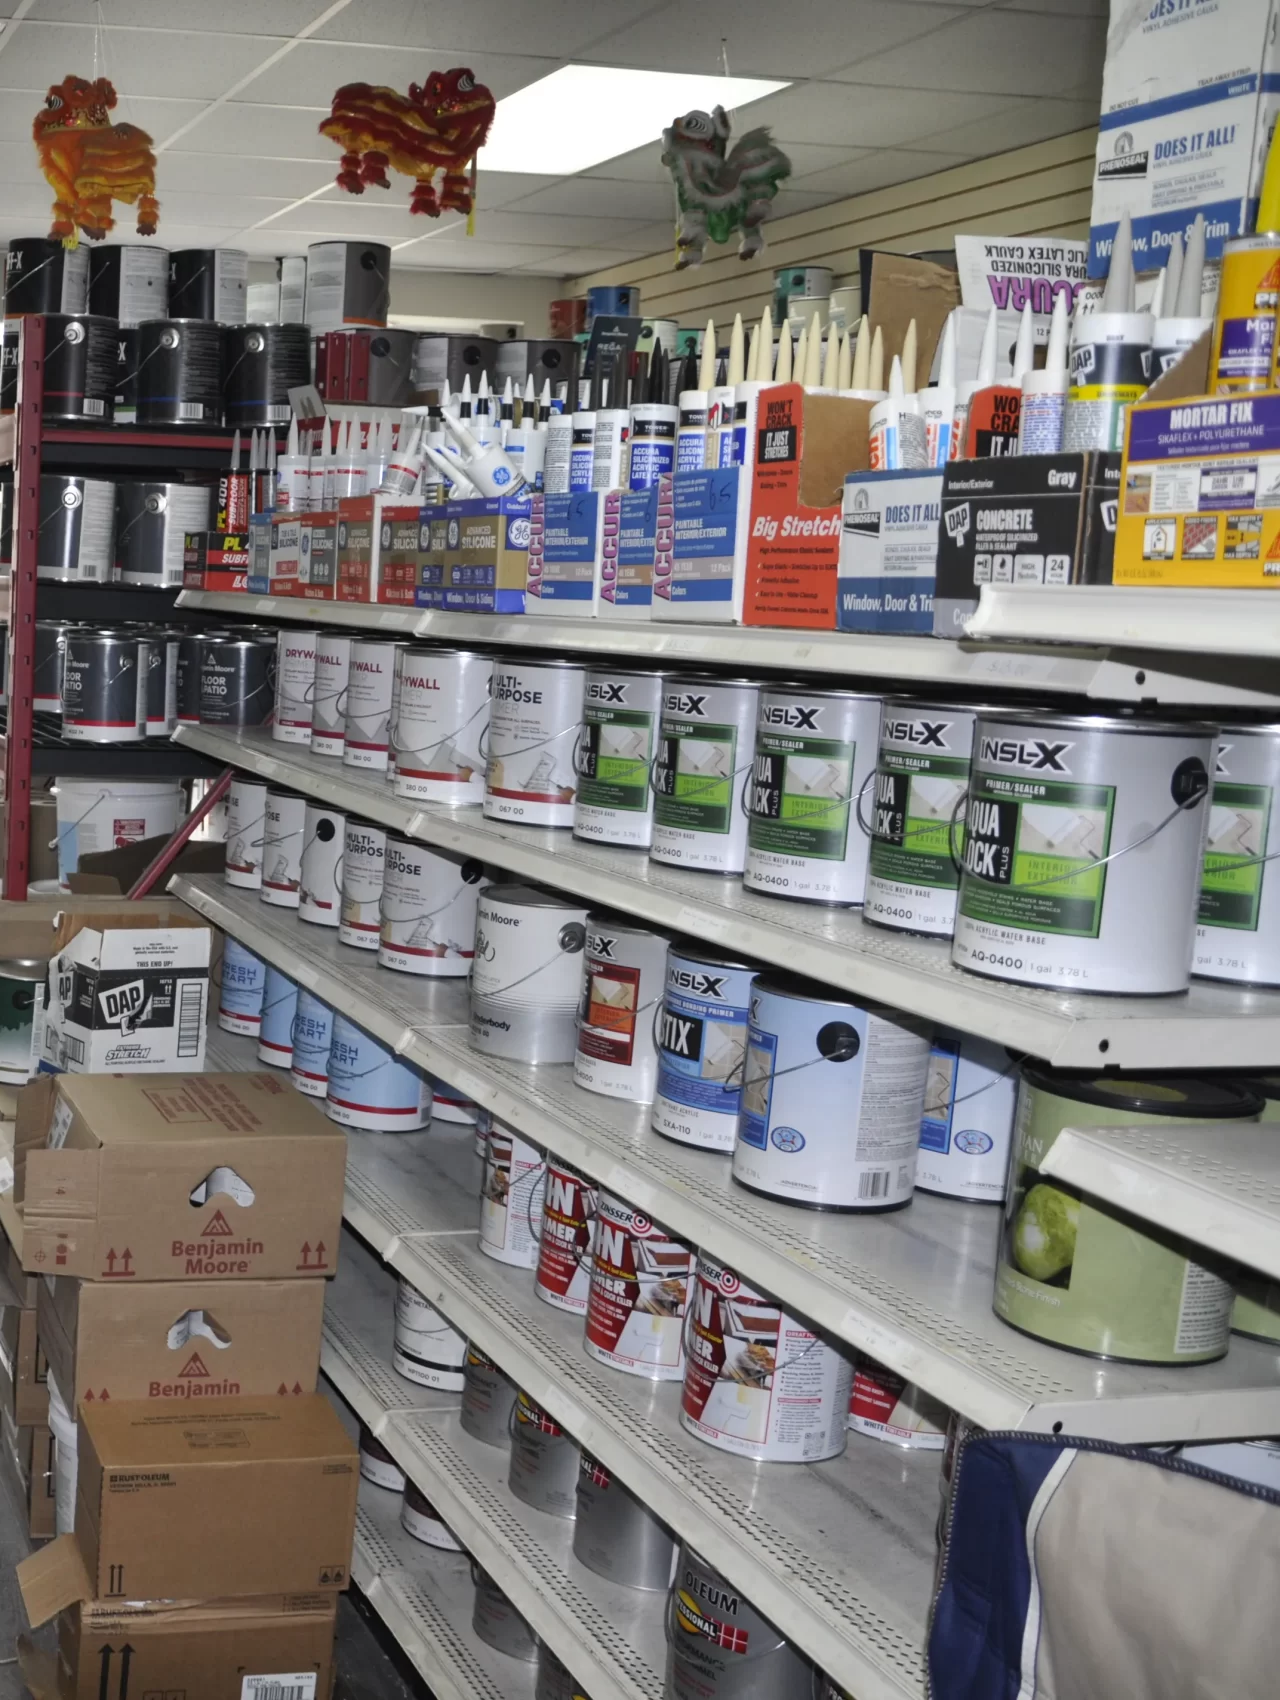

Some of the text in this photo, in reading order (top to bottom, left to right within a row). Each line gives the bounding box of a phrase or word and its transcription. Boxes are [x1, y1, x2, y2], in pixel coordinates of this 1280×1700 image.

[1228, 82, 1251, 95] WHITE
[1154, 125, 1236, 161] DOES IT ALL!
[1099, 153, 1147, 173] PHENOSEAL
[984, 245, 1064, 261] LATEX CAULK
[991, 260, 1061, 276] SILICONIZED
[767, 400, 793, 415] WON'T
[1170, 401, 1254, 429] MORTAR FIX
[765, 413, 792, 428] CRACK
[679, 437, 704, 447] ACCURA
[765, 430, 789, 447] IT JUST
[1158, 424, 1265, 445] SIKAFLEX POLYURETHANE
[632, 456, 670, 465] SILICONIZED
[633, 447, 660, 456] ACCURA
[631, 463, 660, 472] ACRYLIC
[948, 479, 994, 490] Interior/Exterior
[1047, 469, 1076, 488] Gray
[217, 478, 228, 529] PL 400
[228, 477, 239, 525] SUBFLOOR
[885, 503, 941, 523] DOES IT ALL
[949, 508, 968, 532] DAP
[976, 509, 1034, 531] CONCRETE
[466, 525, 492, 536] ADVANCED
[675, 518, 703, 529] PAINTABLE
[752, 514, 841, 541] Big Stretch
[223, 536, 242, 551] PL
[461, 535, 496, 549] SILICONE
[601, 494, 621, 604] ACCUR
[221, 553, 248, 564] SUBF
[1051, 558, 1065, 572] 24
[842, 593, 935, 612] Window, Door & Tri
[494, 687, 543, 704] URPOSE
[584, 683, 626, 703] NSL-X
[663, 694, 707, 716] NSL-X
[761, 705, 820, 731] NSL-X
[882, 720, 948, 748] NSL-X
[885, 754, 931, 769] PRIMER/SEALER
[980, 738, 1069, 772] INSL-X
[985, 778, 1046, 797] PRIMER/SEALER
[513, 807, 524, 816] 00
[771, 789, 780, 817] PLUS
[346, 842, 383, 858] PURPOS
[790, 859, 806, 868] BASE
[999, 845, 1010, 880] PLUS
[753, 871, 789, 888] AQ-0400
[895, 885, 931, 899] WATER BASE
[490, 912, 520, 927] Moore
[873, 902, 913, 920] AQ-0400
[975, 925, 1047, 946] ACRYLIC WATER BASE
[150, 960, 161, 968] END
[971, 947, 1080, 978] AQ-0400 gal 3.78
[1197, 955, 1240, 969] gal 3.78
[670, 970, 725, 1000] NSL-X
[105, 985, 141, 1018] DAP
[707, 1006, 735, 1019] PRIMER
[105, 1047, 152, 1061] STRETCH
[599, 1200, 633, 1223] ZINSSER
[171, 1238, 264, 1262] Benjamin
[184, 1256, 248, 1275] Moore
[148, 1377, 241, 1399] Benjamin
[684, 1570, 739, 1616] OLEUM
